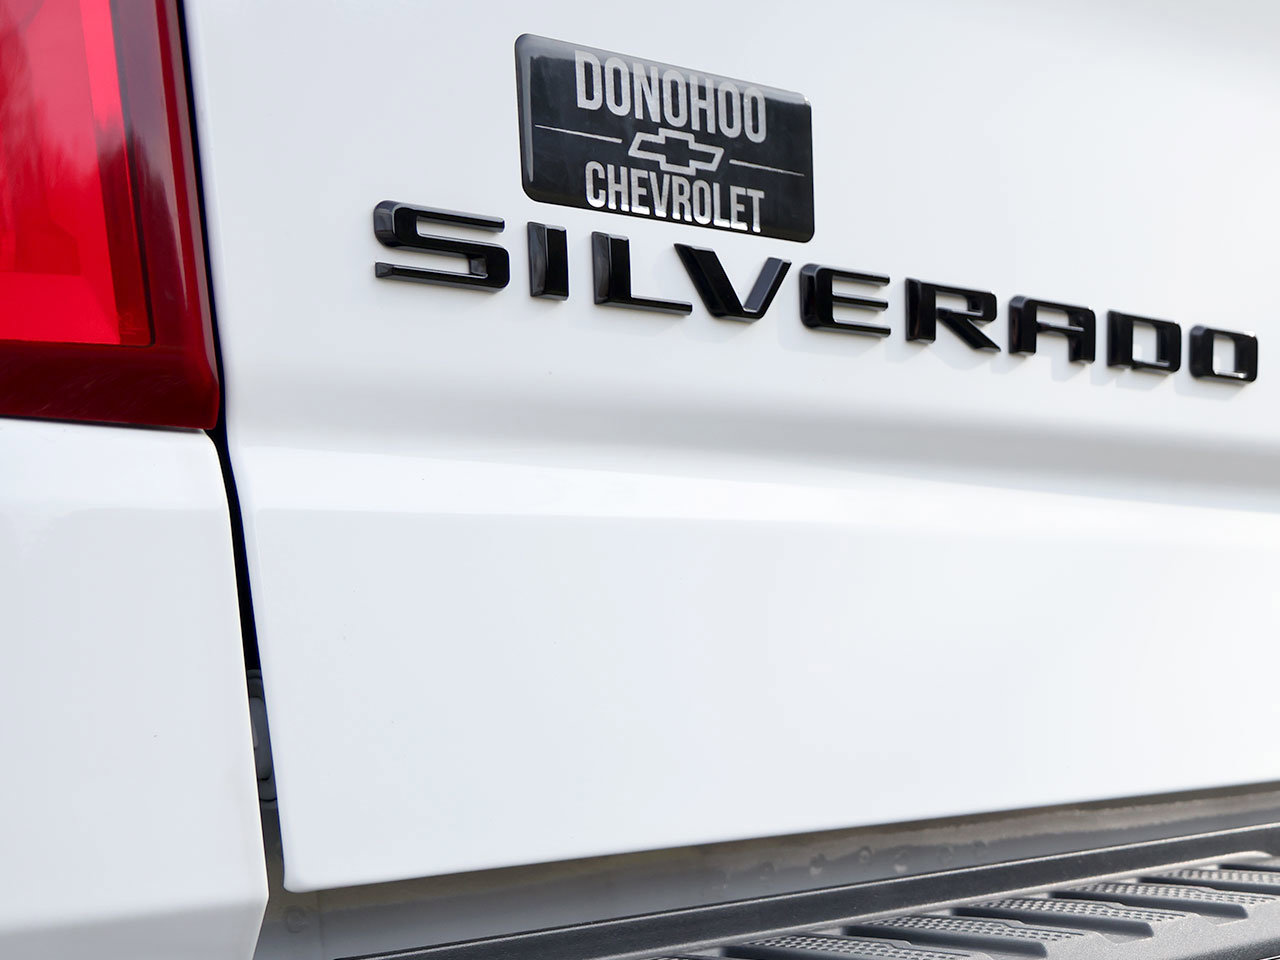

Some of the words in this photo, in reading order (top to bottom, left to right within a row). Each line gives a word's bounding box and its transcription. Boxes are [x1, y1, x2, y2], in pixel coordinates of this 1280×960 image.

[574, 49, 767, 145] DONOHOO
[584, 160, 765, 234] CHEVROLET
[373, 198, 1258, 384] SILVERADO
